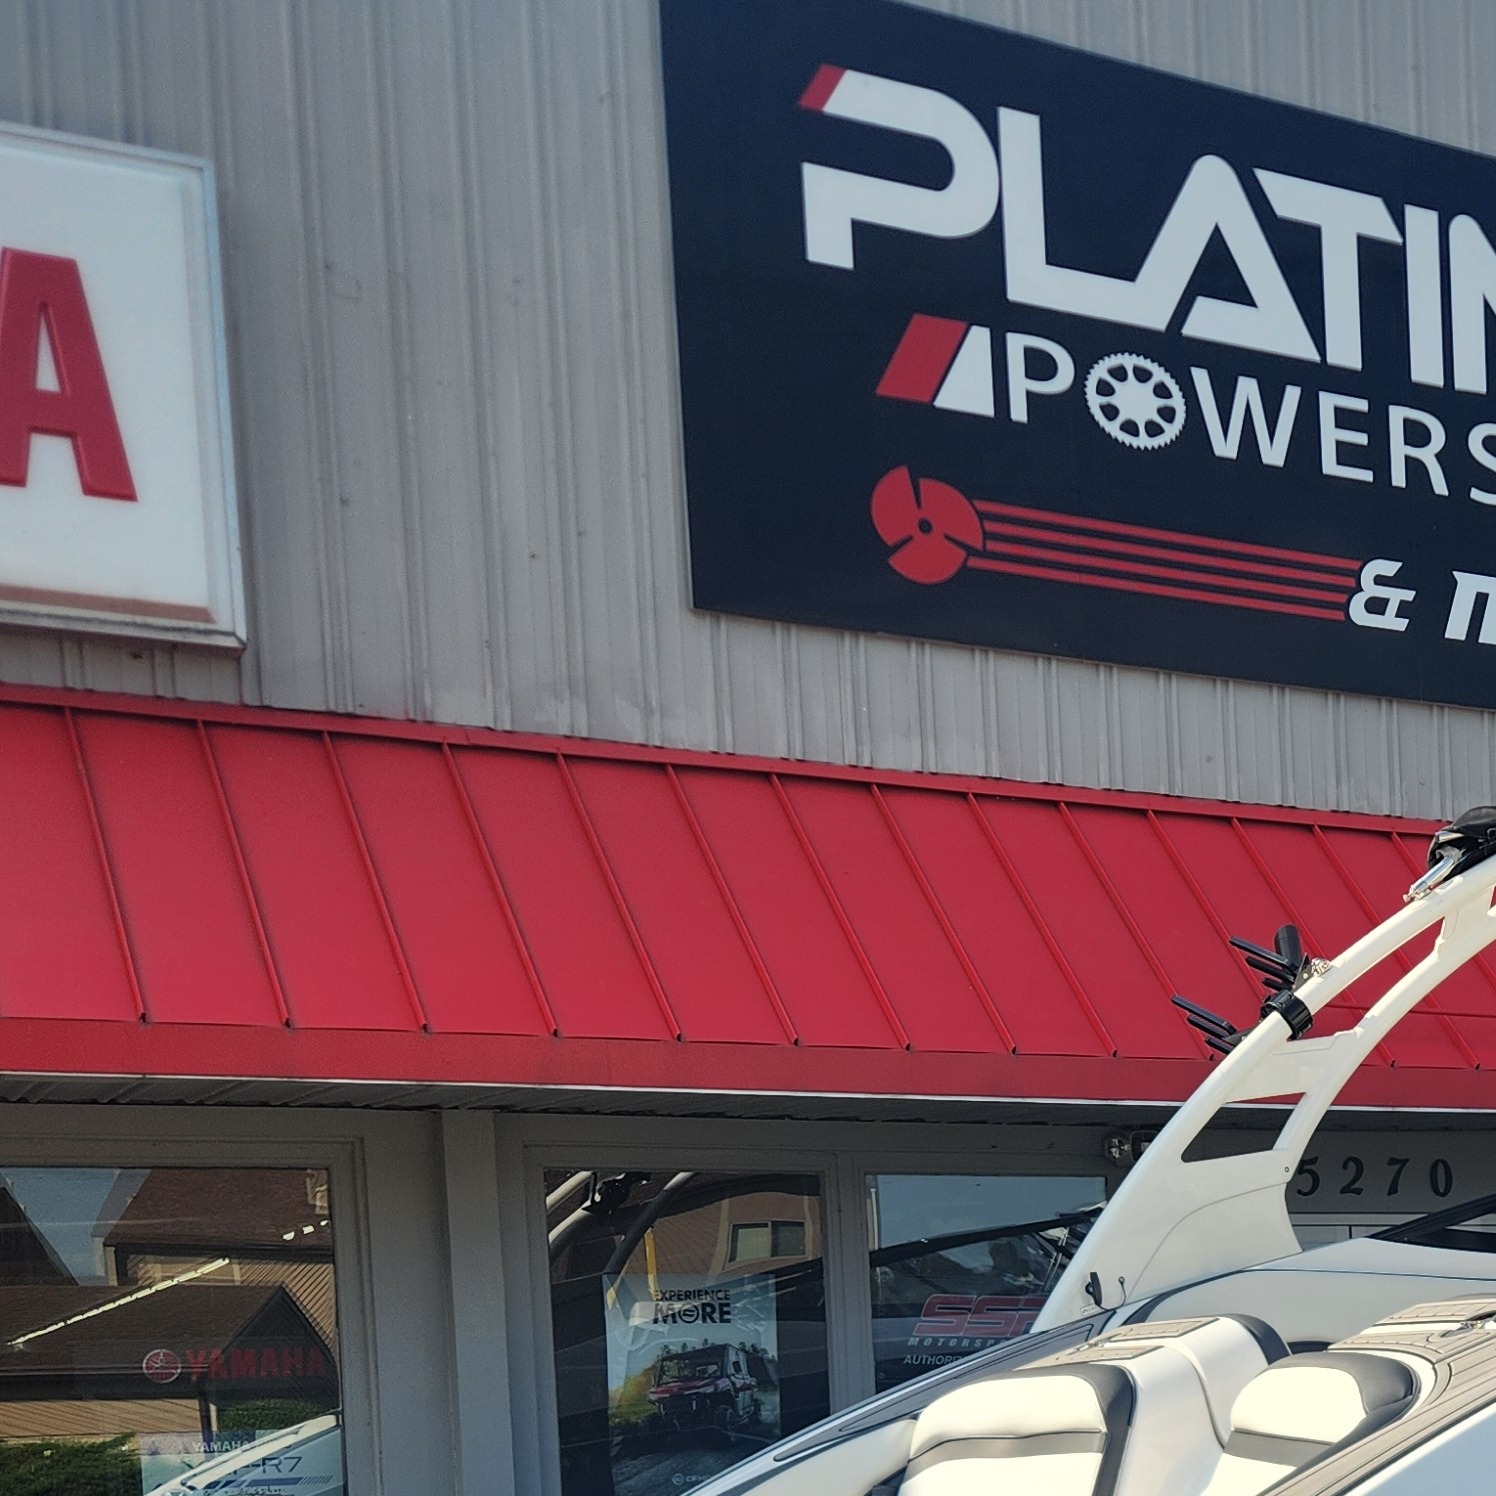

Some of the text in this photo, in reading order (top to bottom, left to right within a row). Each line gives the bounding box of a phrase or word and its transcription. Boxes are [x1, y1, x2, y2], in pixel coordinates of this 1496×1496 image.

[1348, 559, 1416, 632] &
[1296, 1155, 1454, 1199] 5270
[653, 1288, 731, 1302] EXPERIENCE
[652, 1301, 732, 1325] MORE
[185, 1347, 327, 1382] YAMAHA
